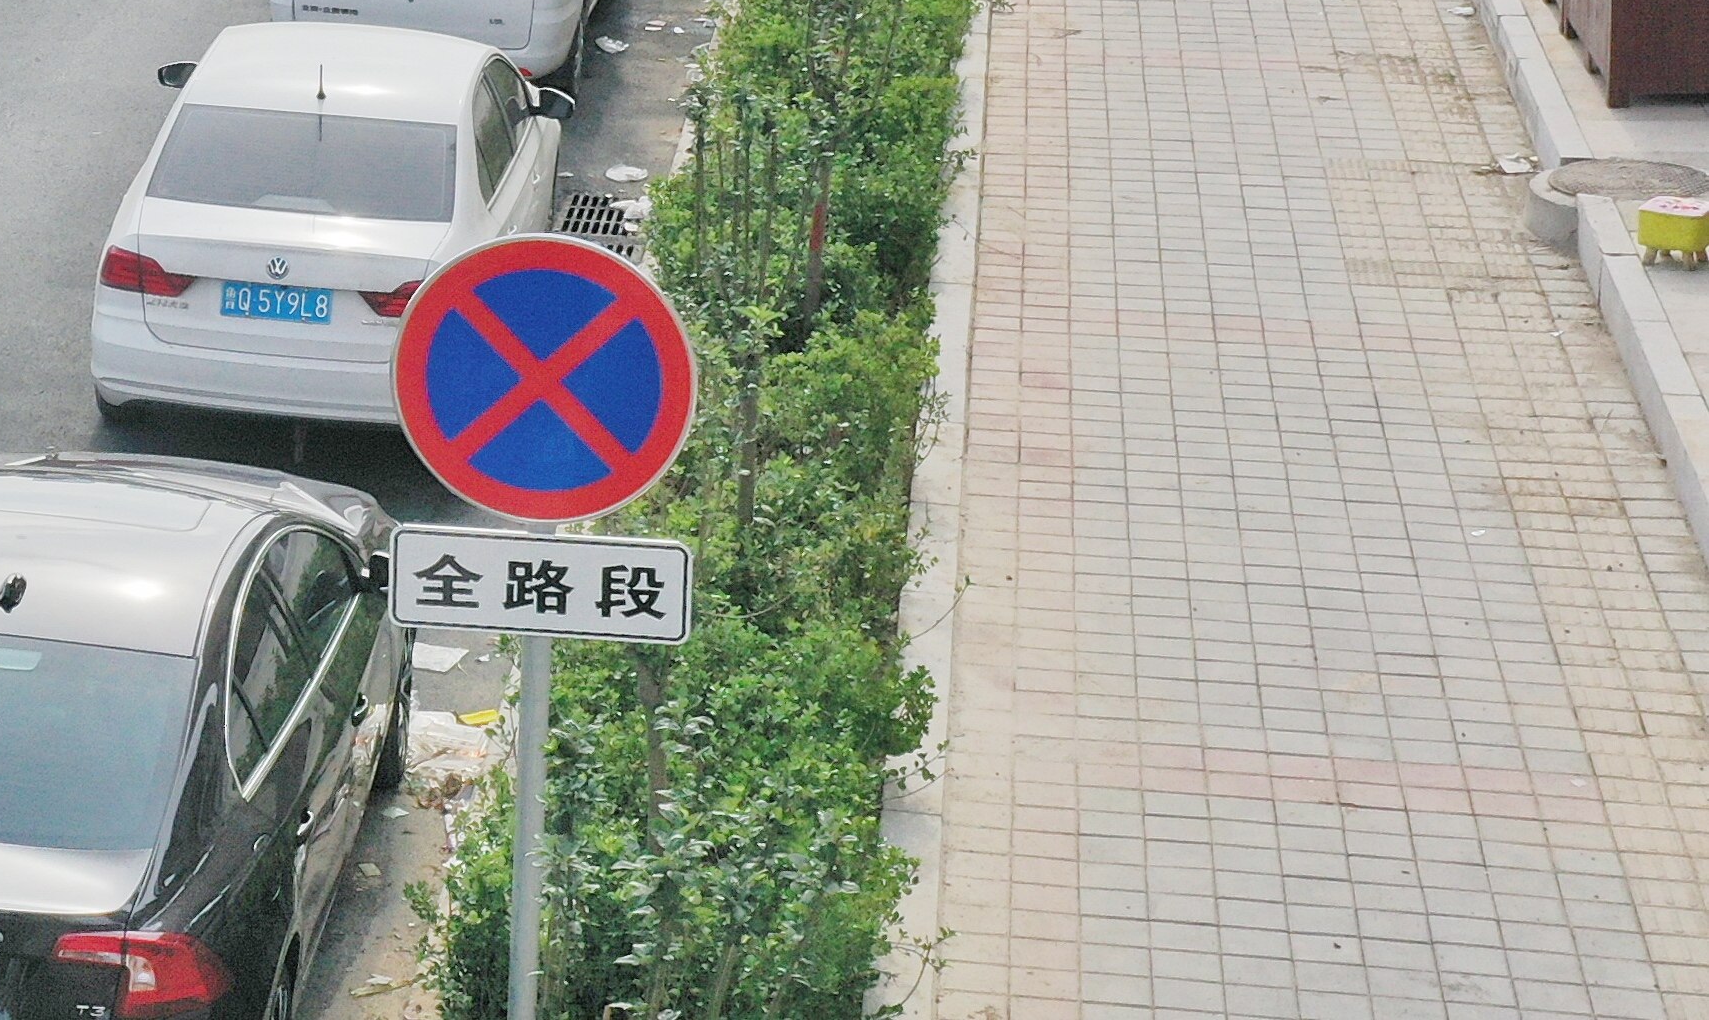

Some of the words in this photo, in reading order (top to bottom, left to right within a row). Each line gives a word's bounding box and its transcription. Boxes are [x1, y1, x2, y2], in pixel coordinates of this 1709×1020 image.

[413, 553, 666, 620] 全路段
[76, 1004, 107, 1017] T3
